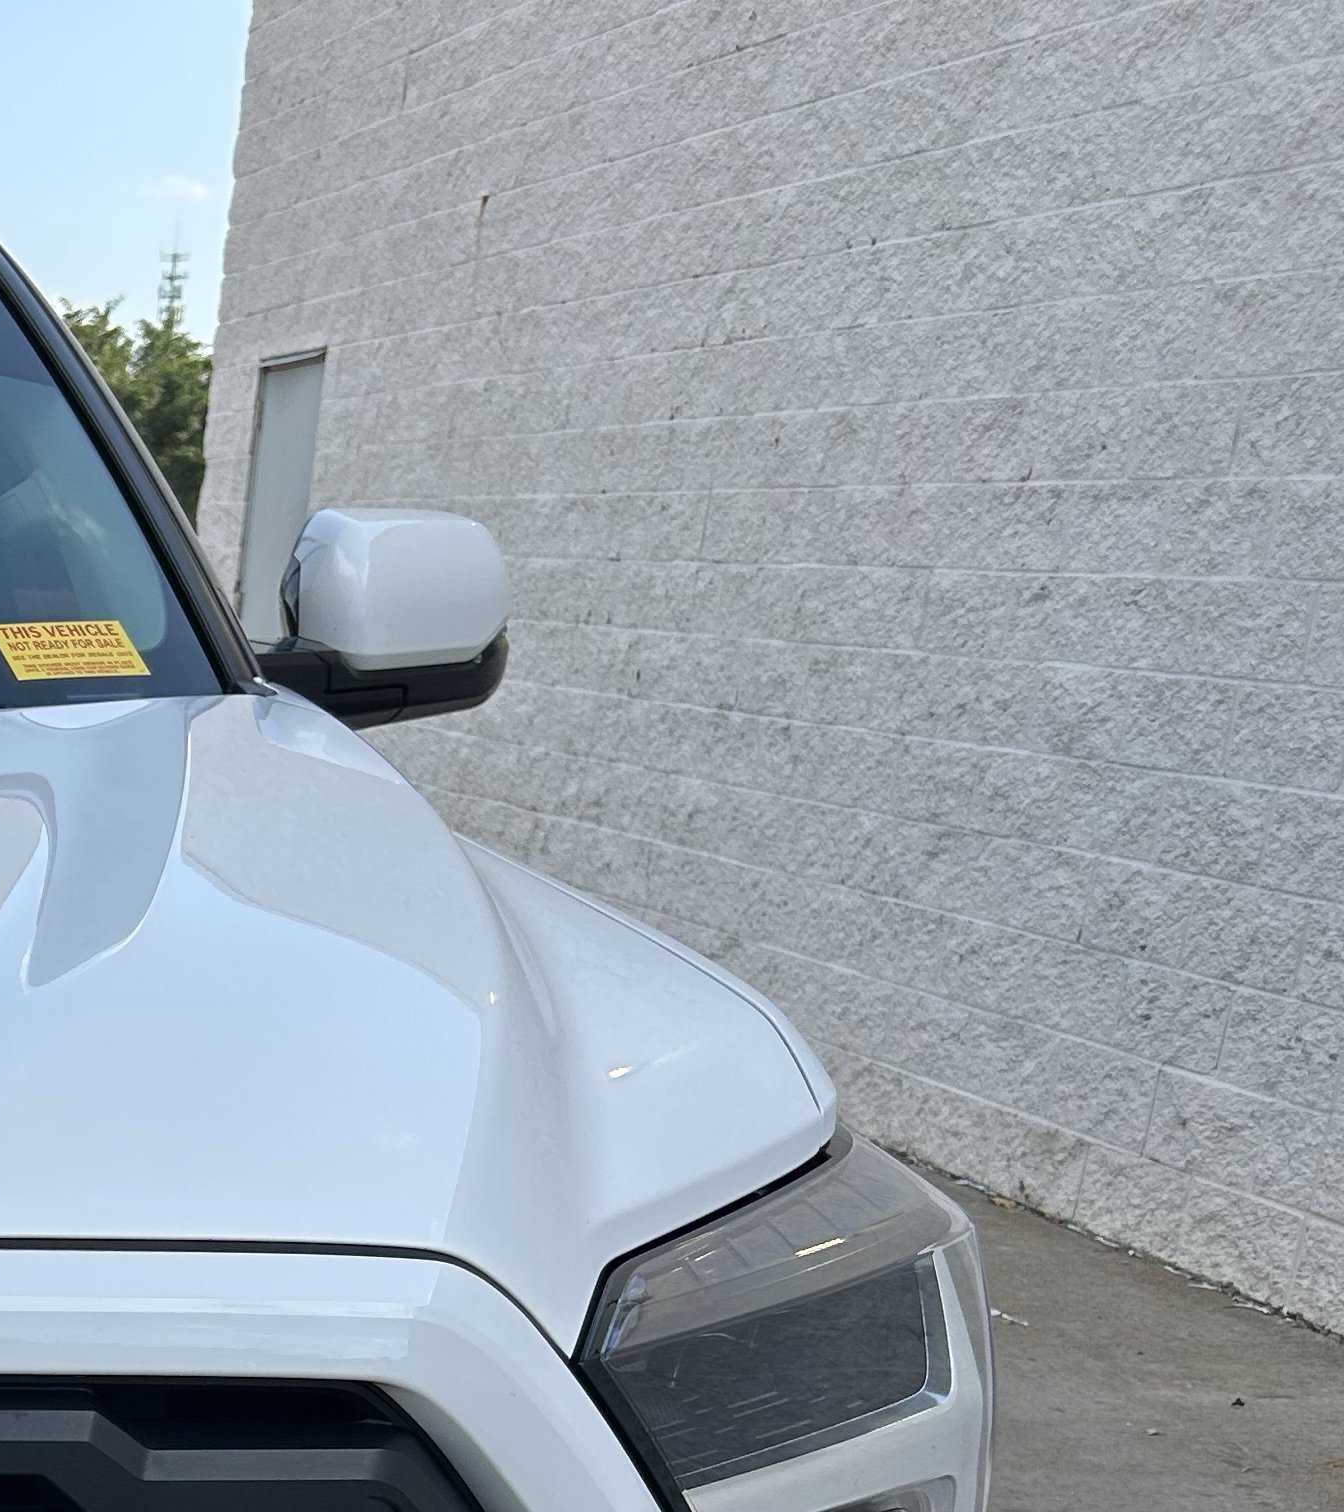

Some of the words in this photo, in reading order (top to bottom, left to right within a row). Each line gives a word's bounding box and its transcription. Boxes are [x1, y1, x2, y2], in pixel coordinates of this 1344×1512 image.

[42, 623, 119, 637] VEHICLE
[7, 641, 33, 652] NOT
[32, 639, 71, 650] READY
[71, 639, 96, 649] FOR
[94, 638, 125, 648] SALE
